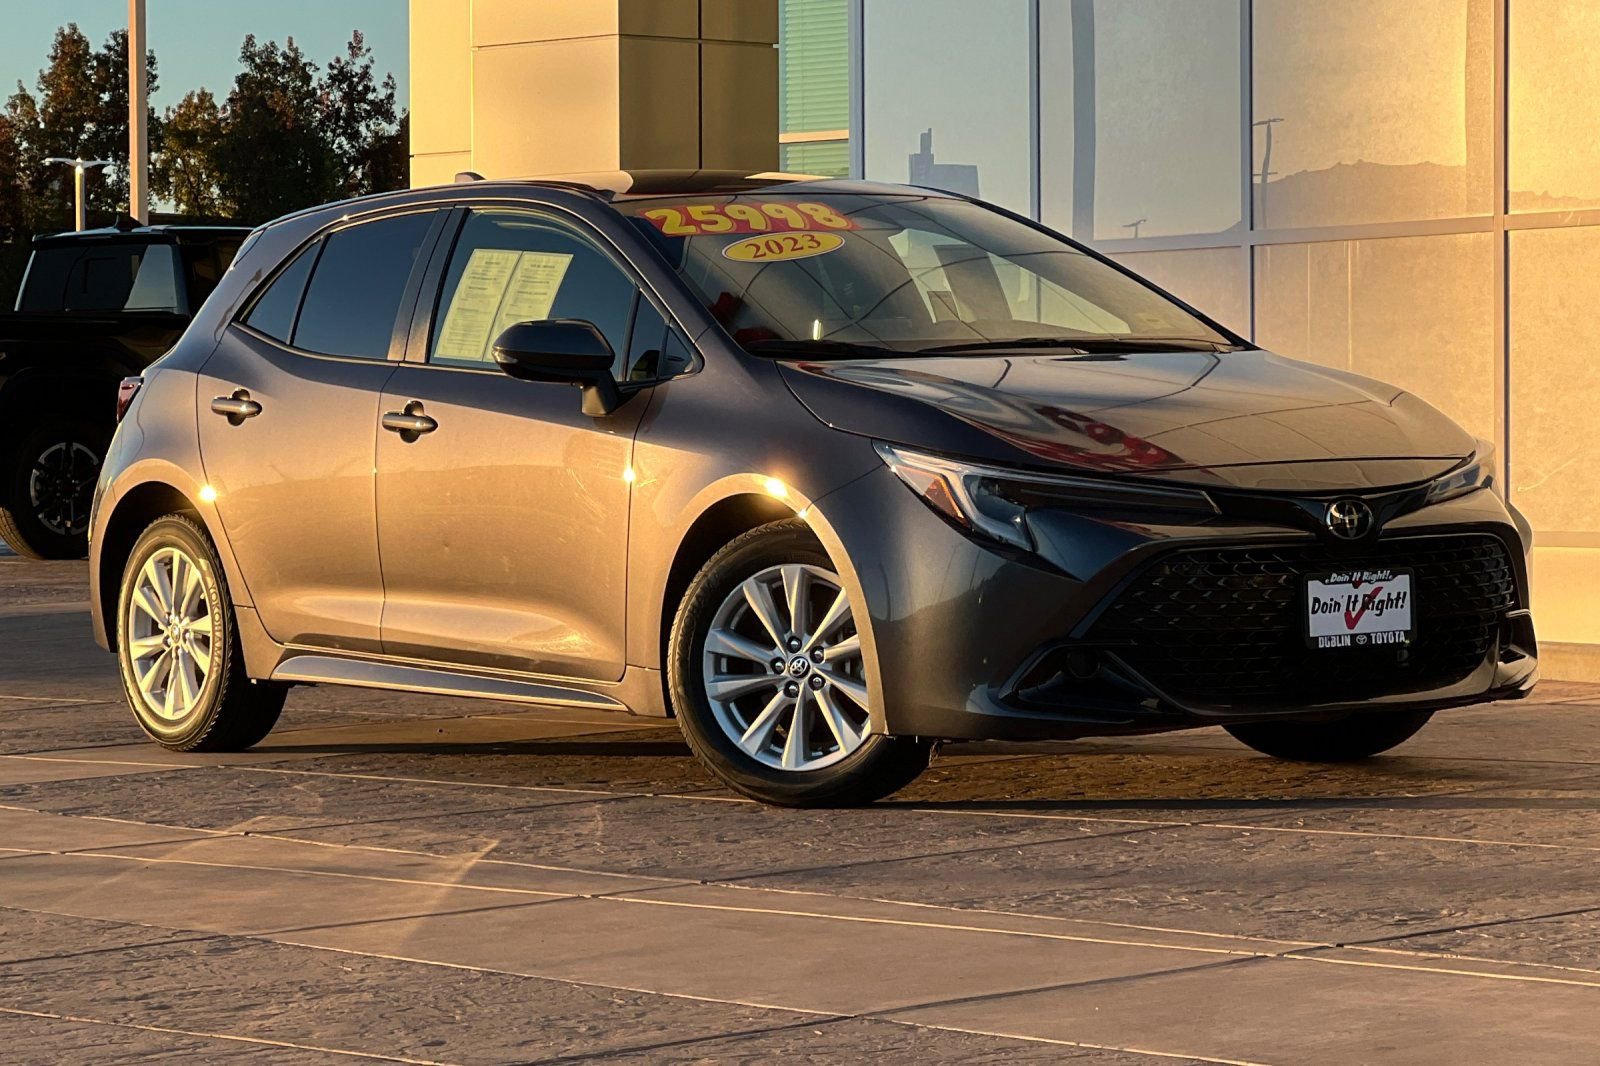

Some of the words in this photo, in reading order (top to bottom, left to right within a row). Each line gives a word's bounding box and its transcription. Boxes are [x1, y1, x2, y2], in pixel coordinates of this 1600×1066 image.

[644, 203, 850, 234] 25998
[745, 233, 822, 259] 2023
[1362, 570, 1391, 584] Right!
[1345, 594, 1359, 612] It
[1360, 591, 1407, 616] Right!
[208, 582, 223, 669] YOKOHAMA
[1318, 634, 1351, 648] DUBLIN
[1370, 631, 1405, 644] TOYOTA
